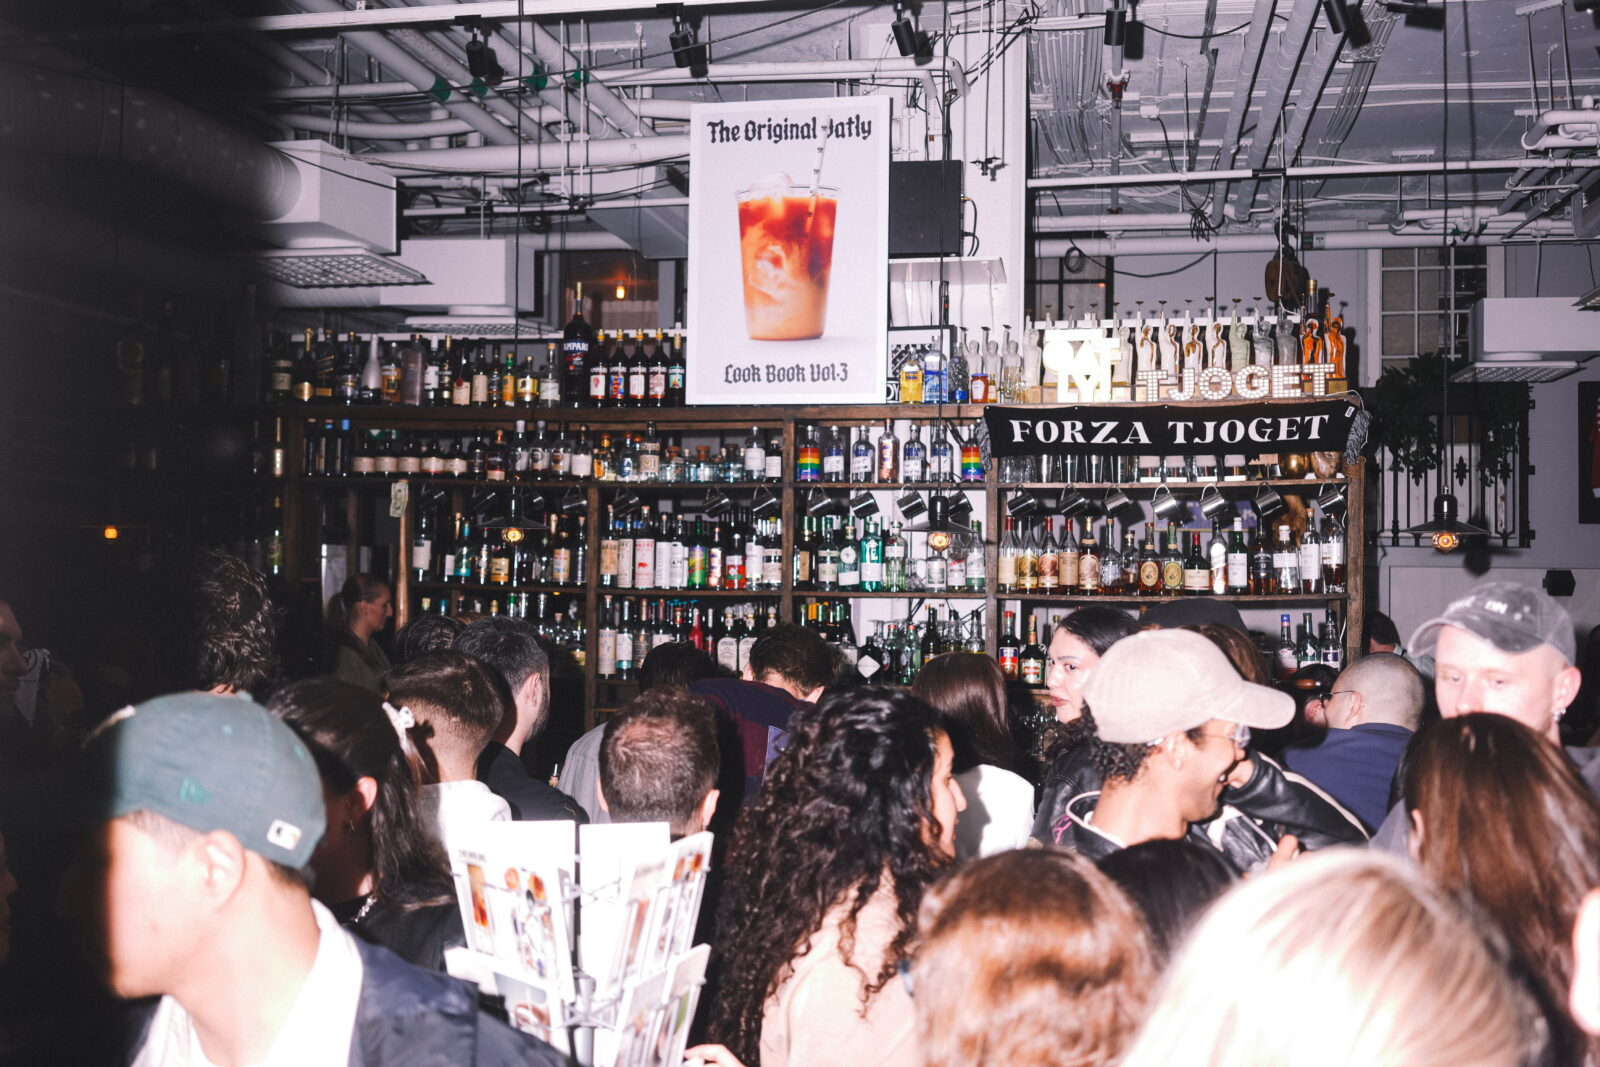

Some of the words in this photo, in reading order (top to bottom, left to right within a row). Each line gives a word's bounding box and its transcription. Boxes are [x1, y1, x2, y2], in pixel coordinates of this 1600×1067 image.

[707, 119, 740, 144] The
[744, 116, 817, 145] Original
[563, 342, 589, 352] AMPARI
[724, 363, 762, 384] Look
[766, 363, 805, 384] Book
[1137, 363, 1336, 402] TJOGET
[1008, 418, 1152, 445] FORZA
[1168, 414, 1330, 445] TJOGET
